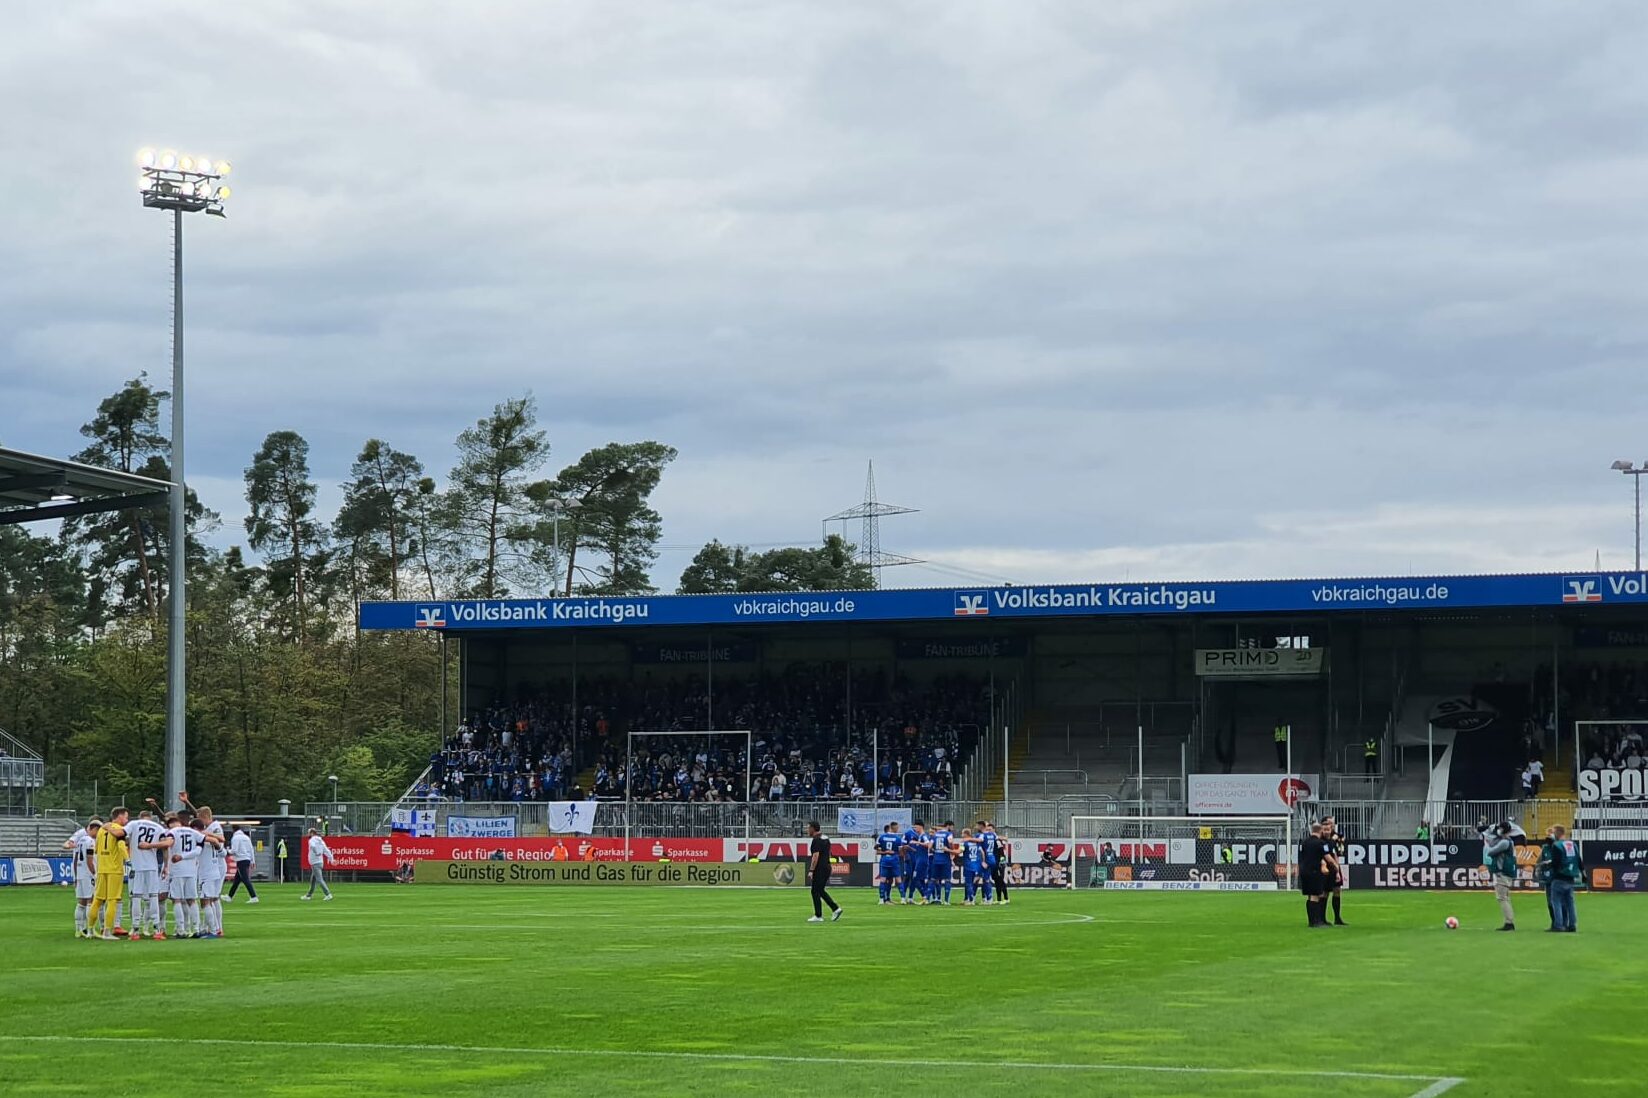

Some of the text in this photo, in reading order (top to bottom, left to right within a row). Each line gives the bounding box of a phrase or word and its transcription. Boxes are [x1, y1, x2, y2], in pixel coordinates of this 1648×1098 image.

[1608, 574, 1648, 595] Vol
[995, 586, 1216, 610] Volksbank Kraichgau
[1312, 584, 1449, 604] vbkraichgau.de
[451, 600, 648, 623] Volksbank Kraichgau
[733, 597, 855, 617] vbkraichgau.de
[1580, 769, 1648, 802] SPO
[475, 820, 508, 828] LILIEN
[180, 834, 192, 852] 15
[471, 830, 513, 838] ZWERGE
[395, 846, 435, 856] Sparkasse
[452, 848, 472, 860] Gut
[517, 848, 551, 861] Regio
[594, 847, 634, 857] Sparkase
[667, 847, 709, 858] Sparkasse
[1605, 848, 1648, 860] Aus der
[327, 857, 368, 867] idelberg
[448, 863, 741, 884] Günstig Strom und Gas für die Region
[1374, 867, 1450, 887] LEICHT
